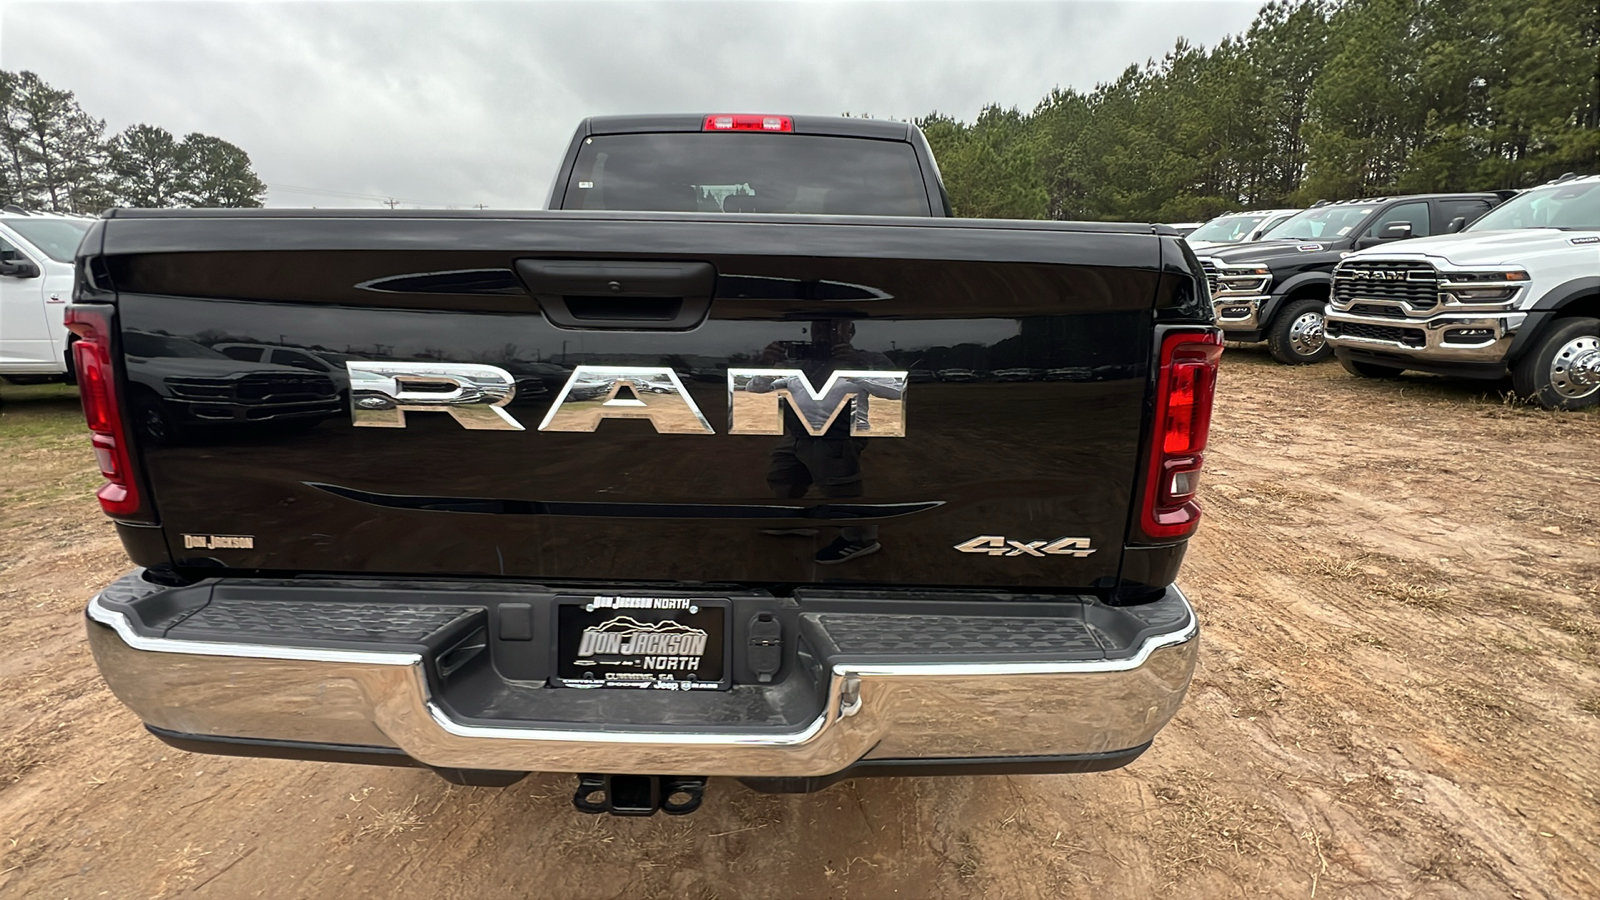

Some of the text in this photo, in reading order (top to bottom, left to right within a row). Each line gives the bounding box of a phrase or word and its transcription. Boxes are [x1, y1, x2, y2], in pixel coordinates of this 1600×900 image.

[1353, 270, 1406, 280] RAM
[346, 361, 908, 437] RAM
[653, 598, 690, 609] NORTH
[578, 631, 708, 656] DON JACKSON
[643, 657, 700, 670] NORTH
